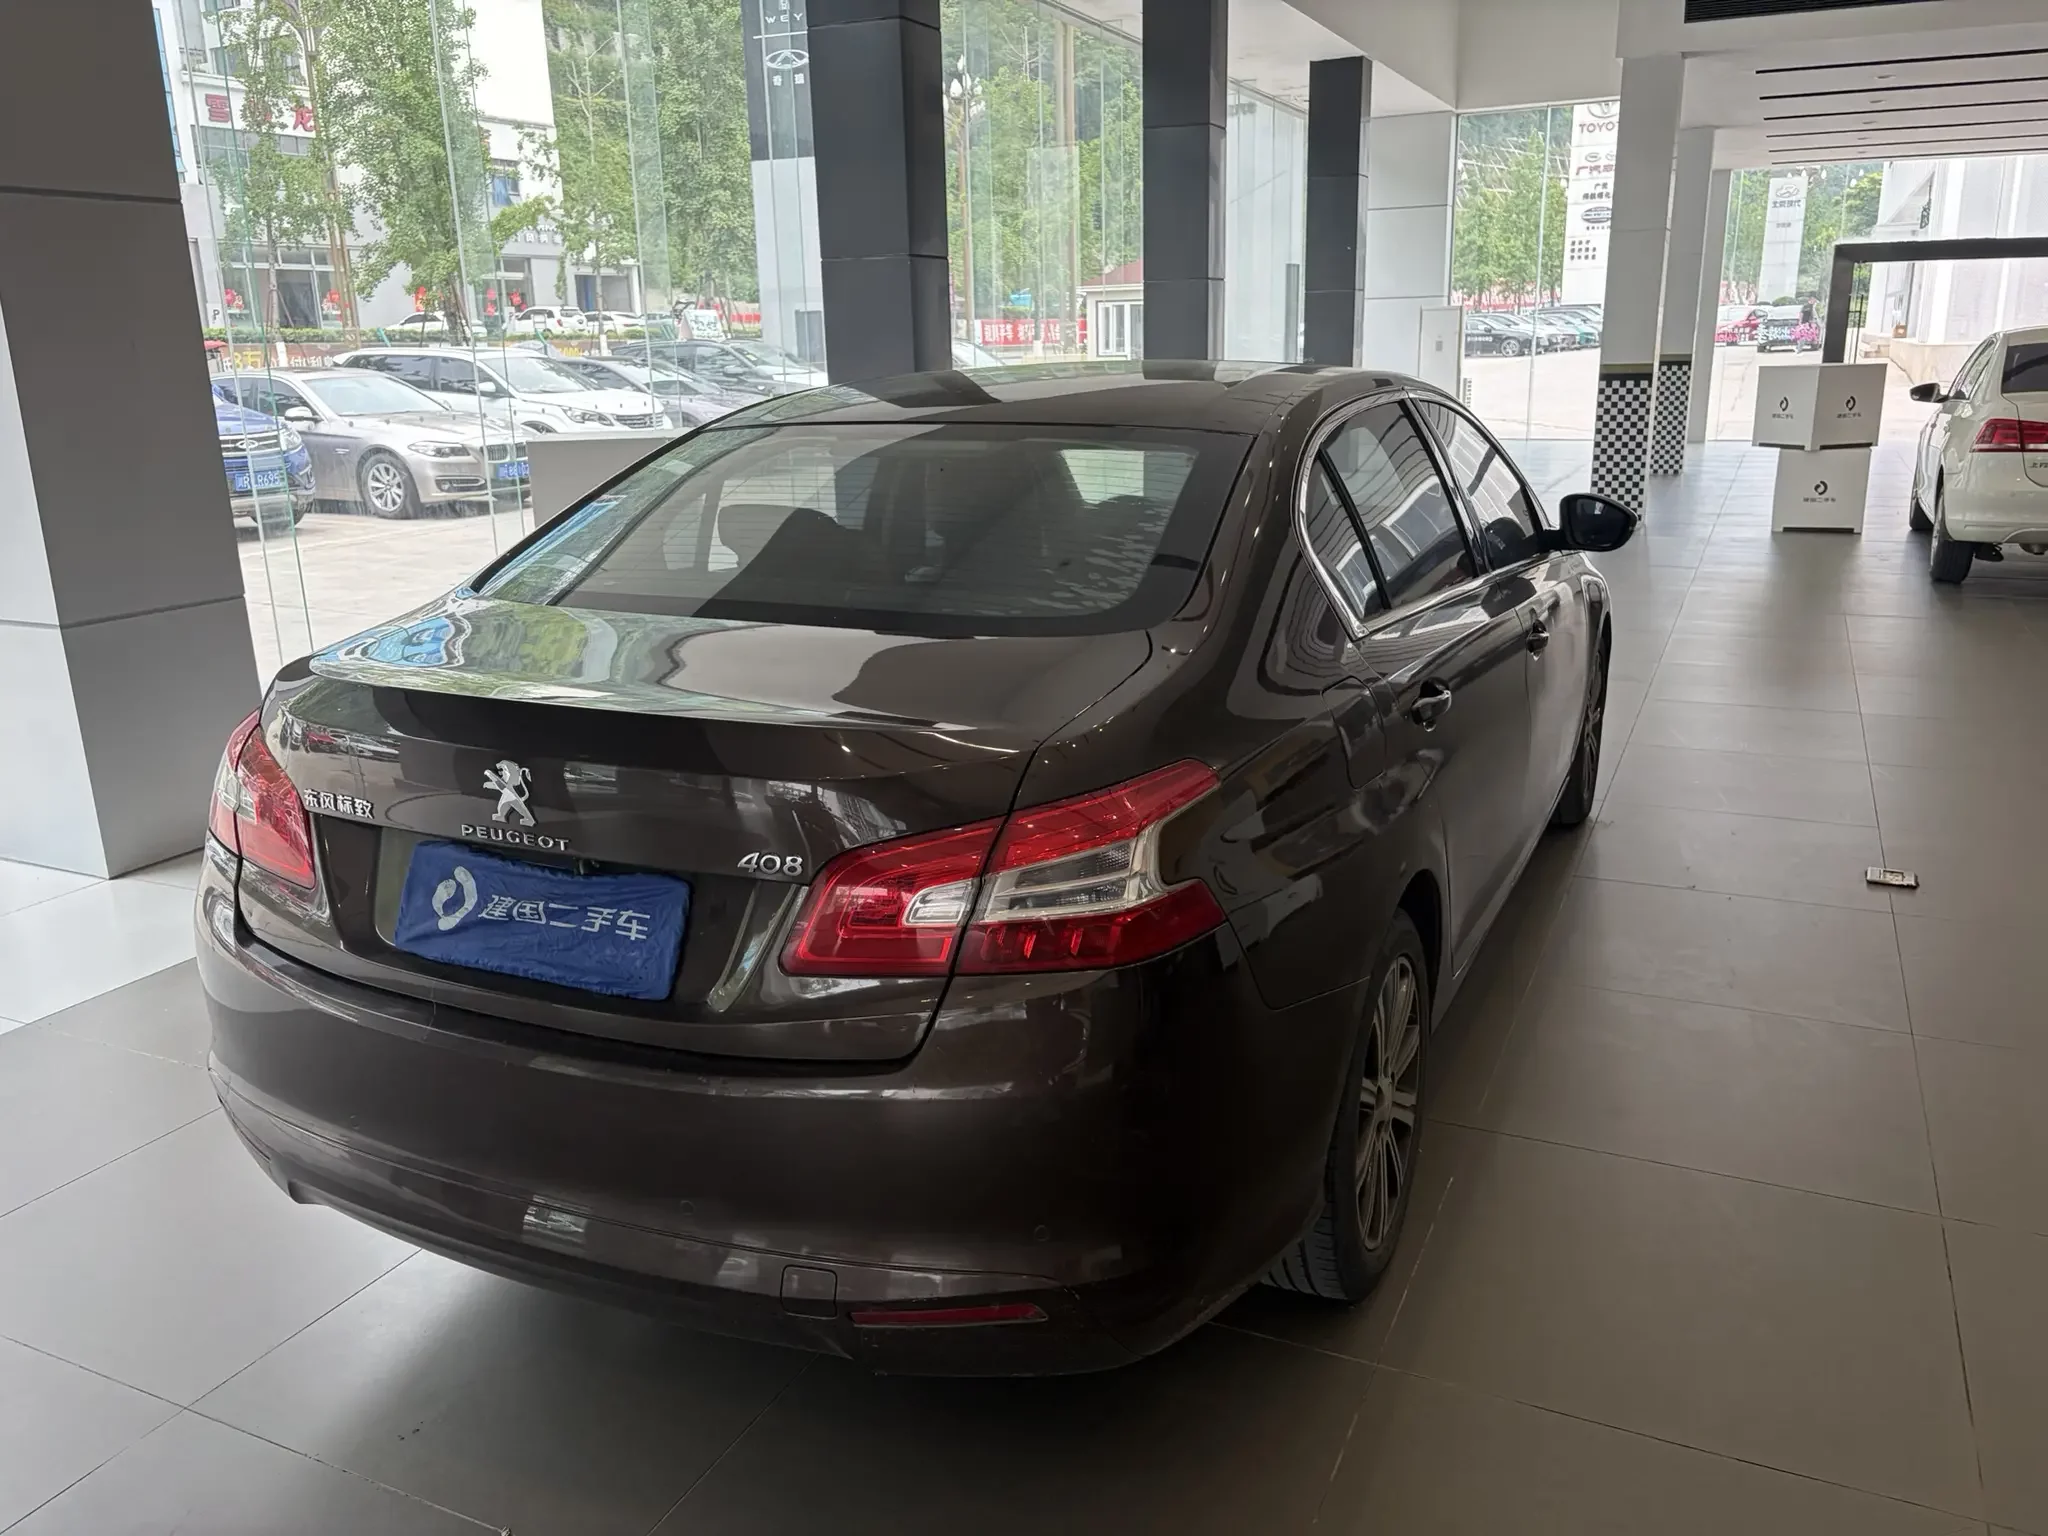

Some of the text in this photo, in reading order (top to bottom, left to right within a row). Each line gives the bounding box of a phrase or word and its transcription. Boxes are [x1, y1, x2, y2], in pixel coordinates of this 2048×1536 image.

[765, 12, 803, 24] WEY
[204, 92, 315, 133] 雪龙
[1579, 120, 1620, 134] TOYO
[303, 788, 374, 820] 东风标致
[460, 823, 570, 851] PEUGEOT
[737, 852, 803, 877] 408
[477, 894, 651, 941] 建国二手车
